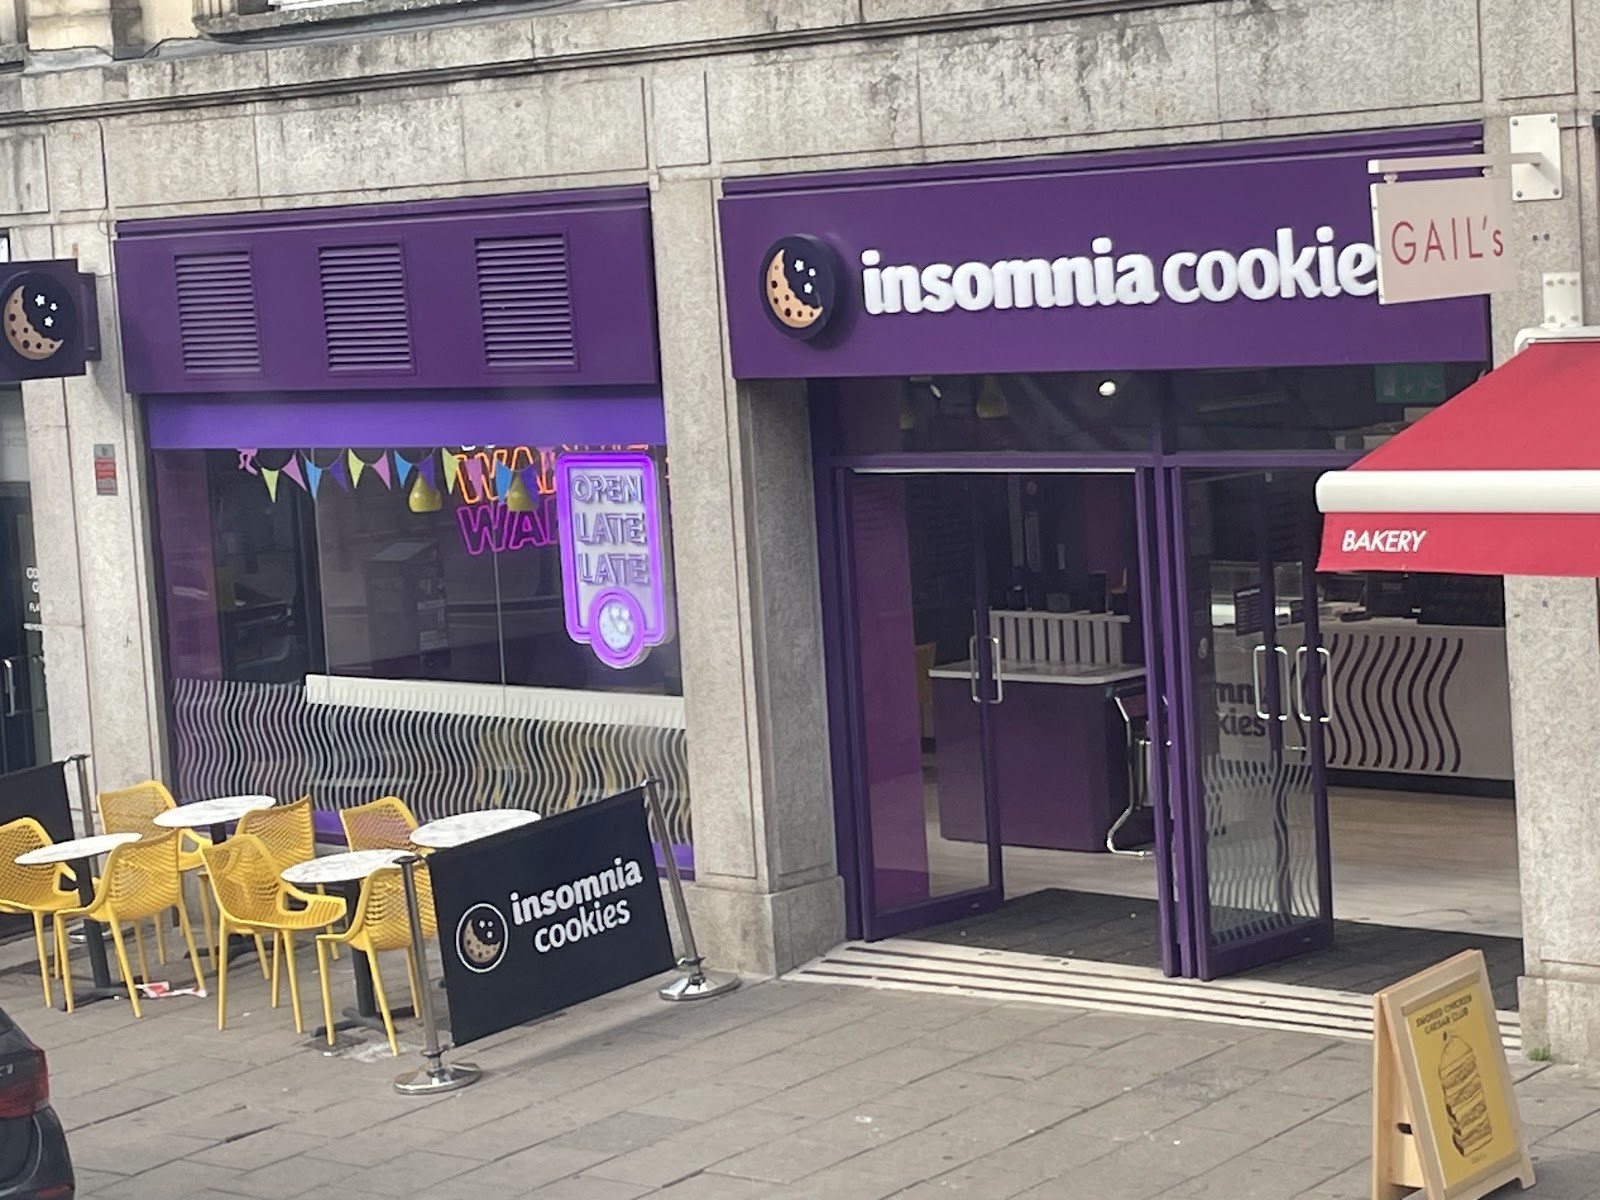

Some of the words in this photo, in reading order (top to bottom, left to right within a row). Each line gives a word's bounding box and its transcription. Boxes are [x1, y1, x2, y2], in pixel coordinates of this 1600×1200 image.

[1391, 215, 1504, 265] GAIL's
[861, 237, 1160, 315] insomnia
[1162, 226, 1377, 304] cookie
[574, 474, 643, 504] OPEN
[575, 512, 647, 546] LATE
[1341, 529, 1427, 553] BAKERY
[577, 553, 650, 585] LATE
[510, 857, 643, 926] insomnia
[534, 899, 631, 954] cookies
